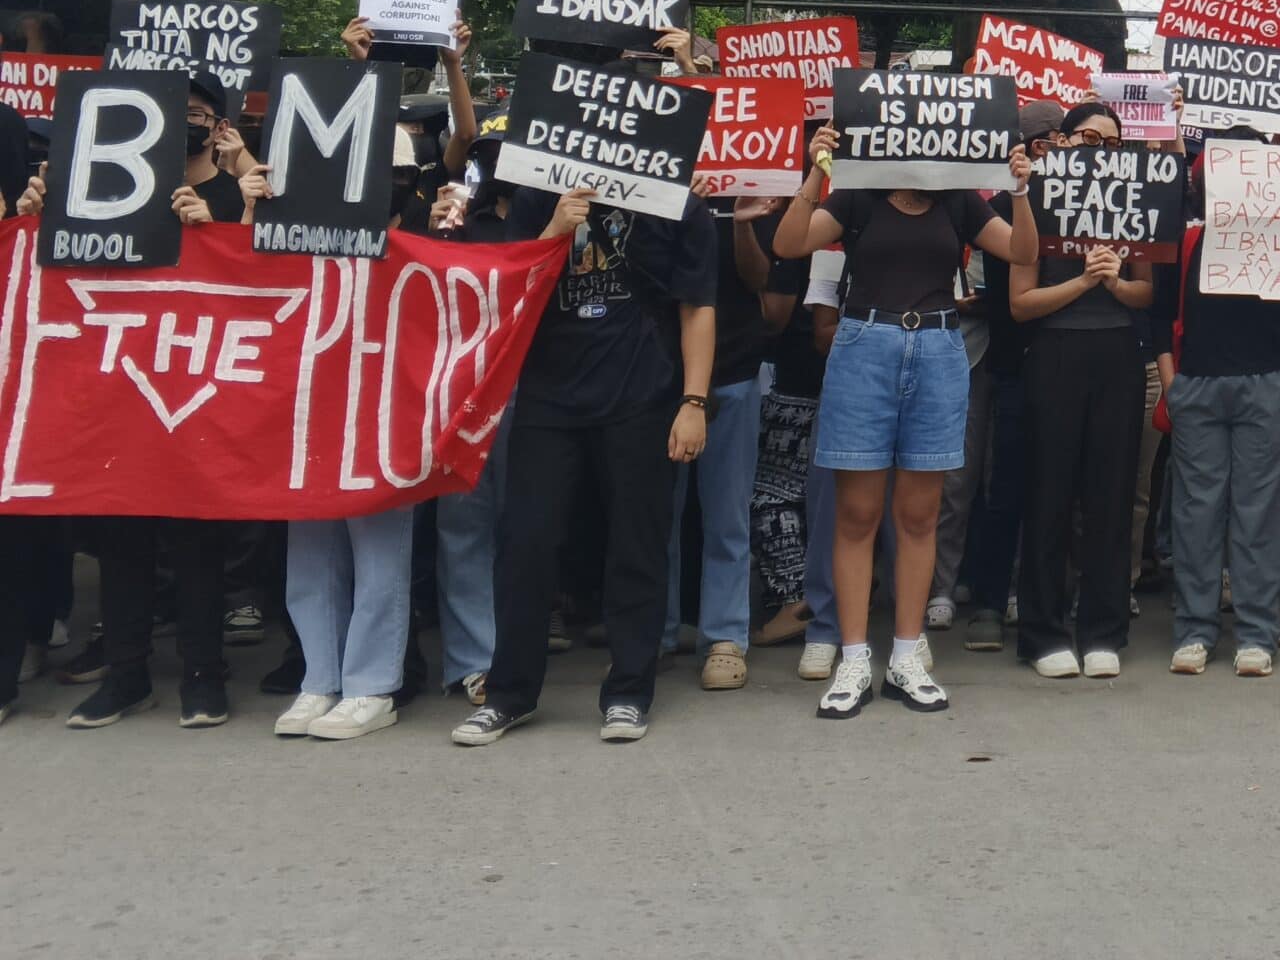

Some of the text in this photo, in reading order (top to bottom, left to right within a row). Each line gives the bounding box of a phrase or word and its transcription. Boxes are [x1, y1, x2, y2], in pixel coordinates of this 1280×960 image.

[139, 4, 259, 33] MARCOS
[391, 1, 431, 11] AGAINST
[205, 33, 253, 64] NG
[726, 26, 842, 62] SAHOD ITAAS
[982, 17, 1047, 59] MGA
[552, 64, 680, 115] DEFEND
[859, 73, 992, 100] AKTIVISM
[1123, 84, 1149, 100] FREE
[579, 102, 639, 135] THE
[880, 100, 975, 126] IS NOT
[67, 88, 165, 220] B
[268, 73, 377, 203] M
[526, 119, 684, 178] DEFENDERS
[845, 126, 1009, 159] TERRORISM
[1092, 151, 1138, 182] SABI
[1146, 153, 1178, 183] KO
[1043, 178, 1143, 214] PEACE
[1246, 180, 1277, 201] NG
[254, 222, 386, 256] MAGNANAKAW
[1054, 209, 1160, 243] TALKS!
[53, 230, 143, 262] BUDOL
[1240, 252, 1272, 267] SA
[83, 312, 272, 382] THE
